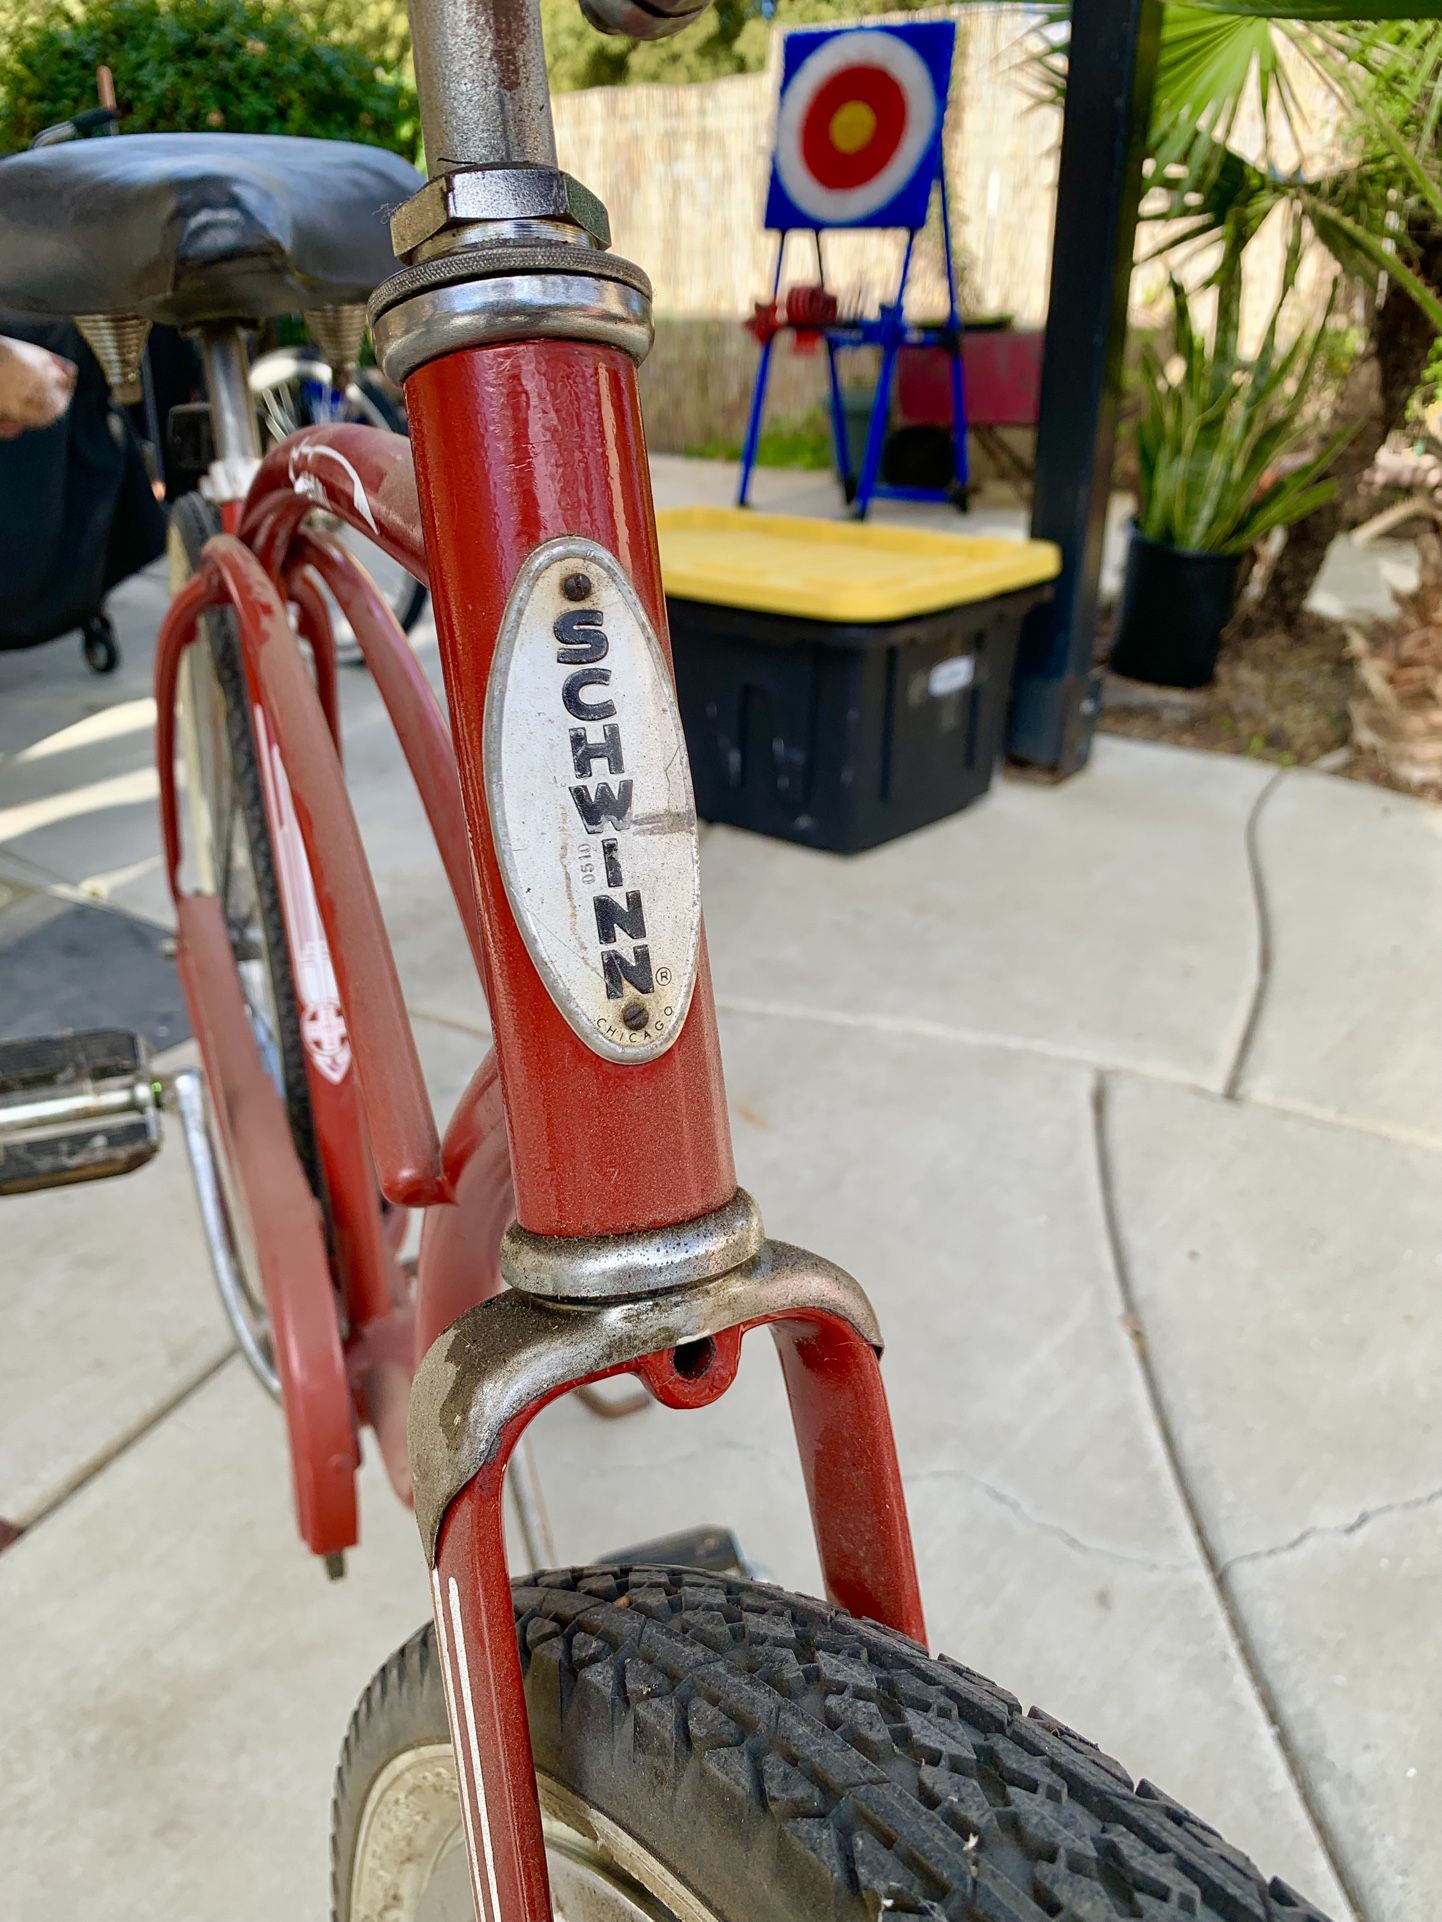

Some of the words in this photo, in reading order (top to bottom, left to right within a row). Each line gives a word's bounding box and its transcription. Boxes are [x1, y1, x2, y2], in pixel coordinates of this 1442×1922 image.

[553, 610, 653, 1000] SCHWINN
[576, 843, 596, 885] 0510
[596, 1006, 673, 1043] CHICAGO
